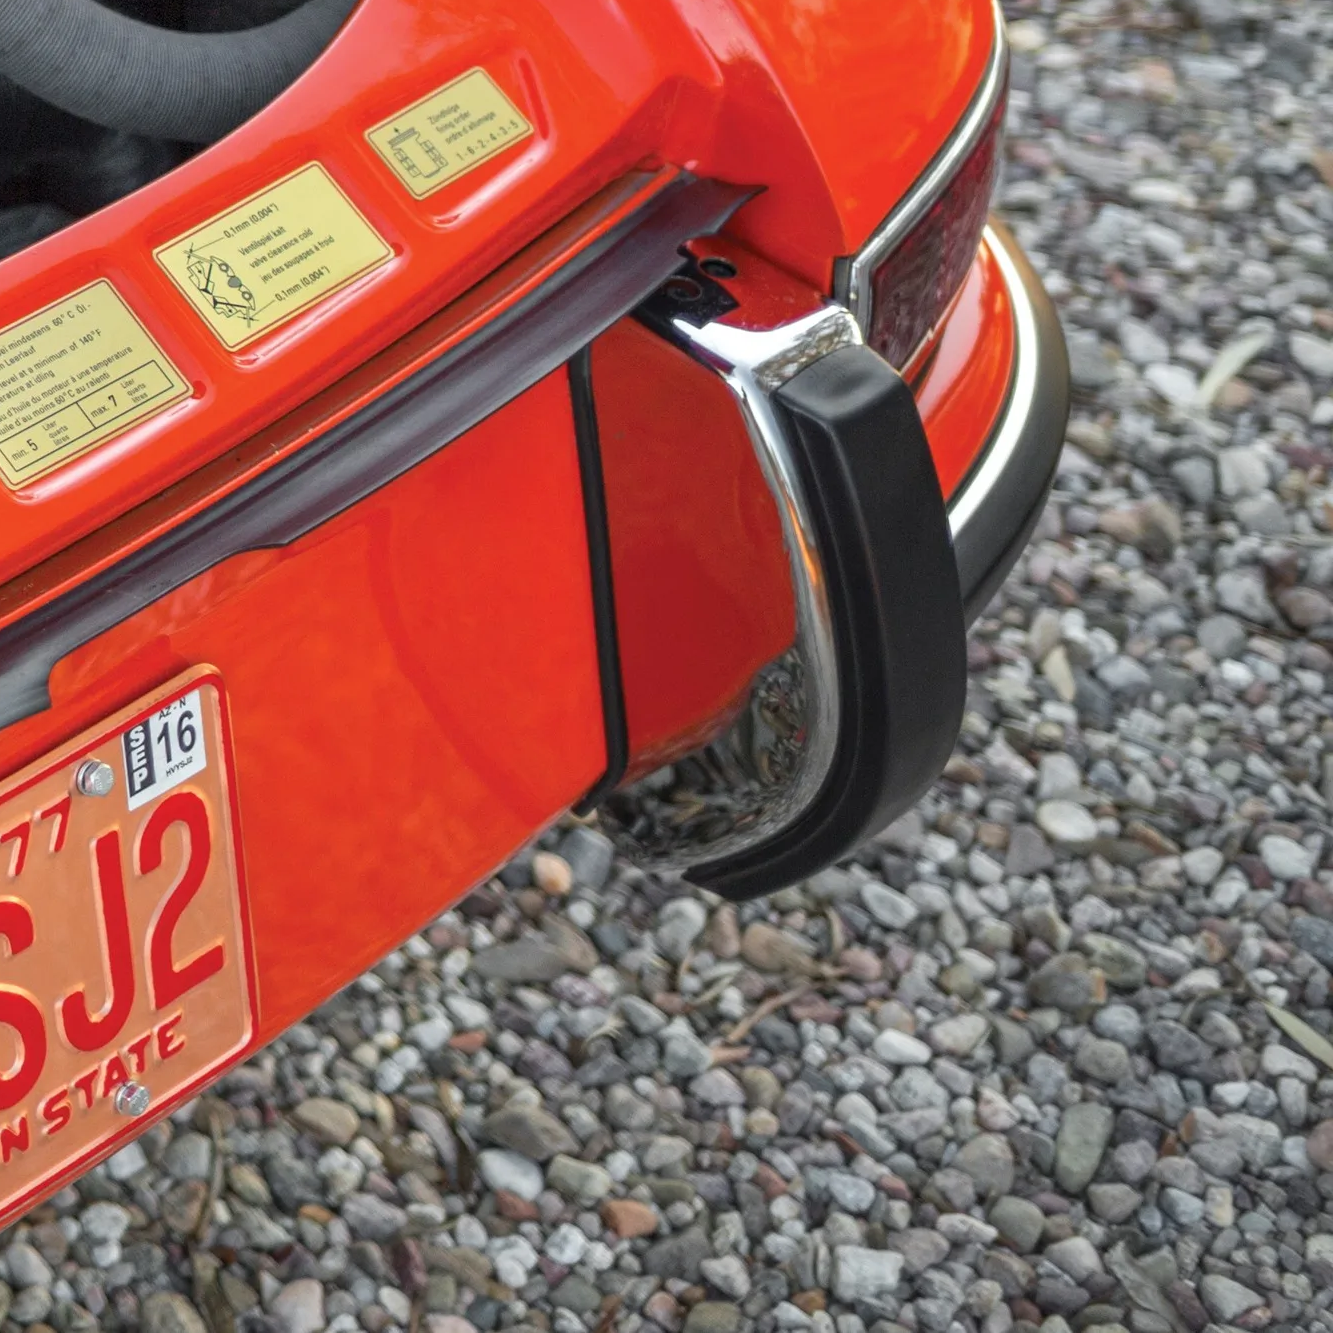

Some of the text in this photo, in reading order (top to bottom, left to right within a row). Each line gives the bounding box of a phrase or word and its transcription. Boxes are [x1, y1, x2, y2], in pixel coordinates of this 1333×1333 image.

[223, 221, 251, 238] 0,1mm
[238, 226, 286, 256] Ventilspiel kalt
[250, 228, 313, 268] valve clearance cold
[261, 274, 273, 284] jeu
[272, 266, 285, 276] des
[283, 248, 315, 269] soupapes
[317, 235, 335, 248] froid
[275, 284, 302, 302] 0,1mm
[8, 325, 51, 350] mindestens
[4, 345, 36, 366] Leerlauf
[18, 370, 28, 378] at
[33, 349, 68, 370] minimum
[69, 341, 78, 351] of
[26, 380, 35, 388] at
[34, 370, 56, 383] idling
[120, 378, 134, 389] Liter
[6, 401, 31, 417] d'huile
[31, 396, 42, 404] du
[41, 379, 70, 399] monteur
[76, 369, 91, 380] une
[32, 402, 56, 417] moins
[75, 386, 86, 394] au
[85, 372, 110, 388] ralenti
[90, 395, 117, 418] max. 7
[42, 421, 56, 431] Liter
[49, 425, 69, 439] quarts
[11, 439, 38, 461] min. 5
[158, 706, 172, 721] AZ
[157, 710, 196, 764] 16
[129, 725, 149, 792] SEP
[0, 797, 72, 878] 77
[43, 1014, 185, 1136] STATE
